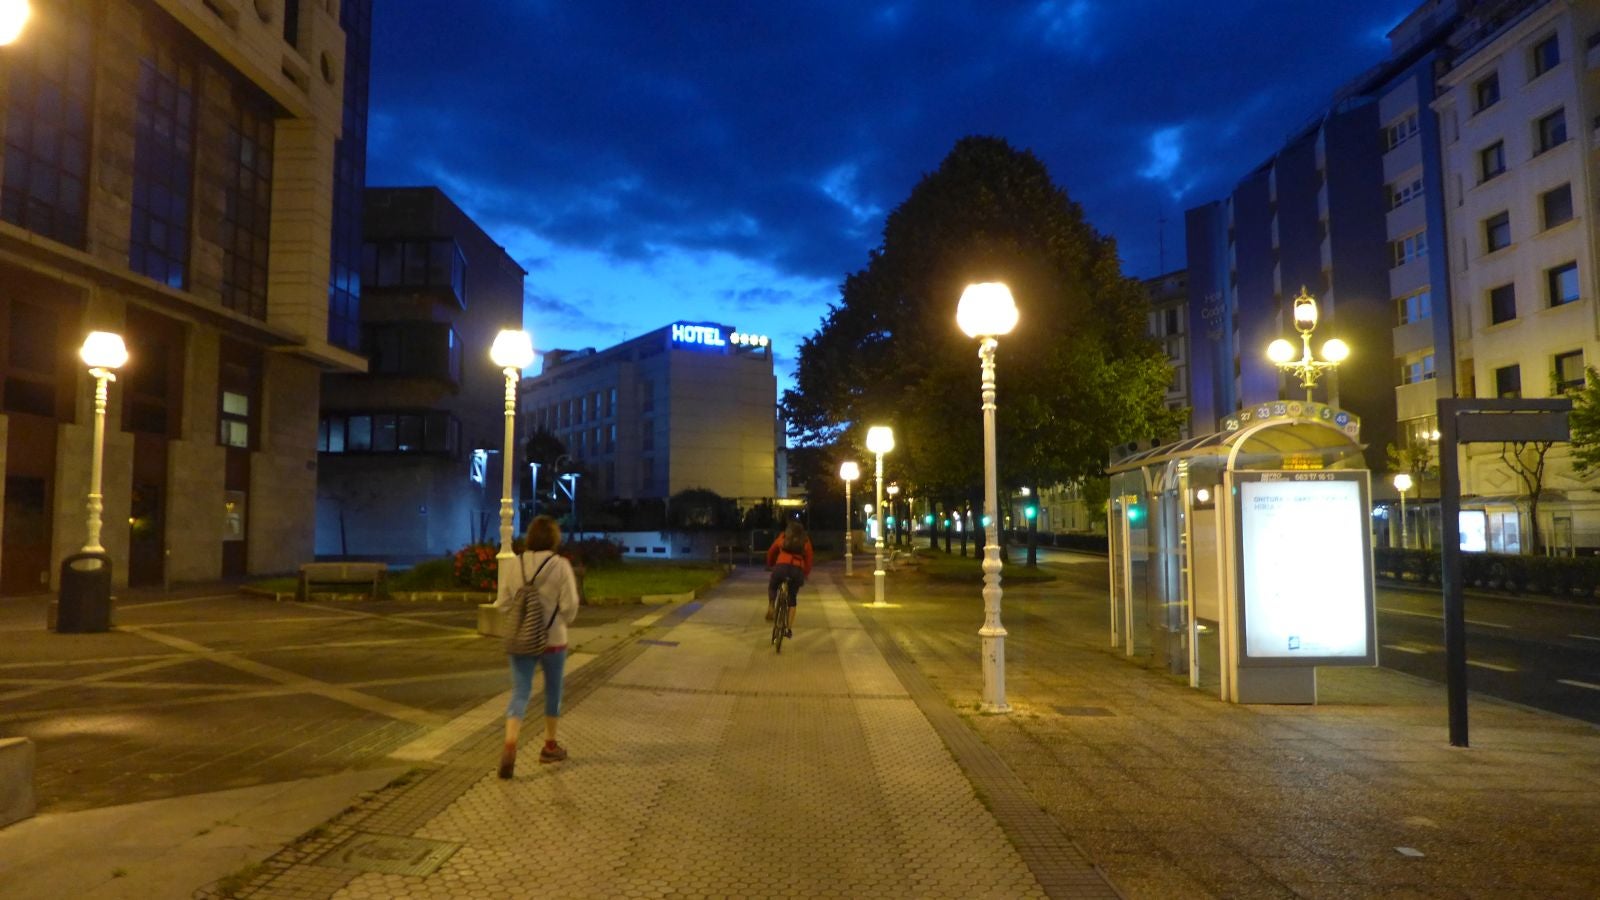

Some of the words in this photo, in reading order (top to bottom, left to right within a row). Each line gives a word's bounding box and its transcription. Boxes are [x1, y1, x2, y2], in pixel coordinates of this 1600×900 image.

[672, 324, 726, 346] HOTEL
[1226, 420, 1239, 431] 25
[1240, 412, 1251, 421] 27
[1258, 408, 1270, 418] 33
[1274, 404, 1286, 415] 35
[1323, 408, 1331, 419] 5
